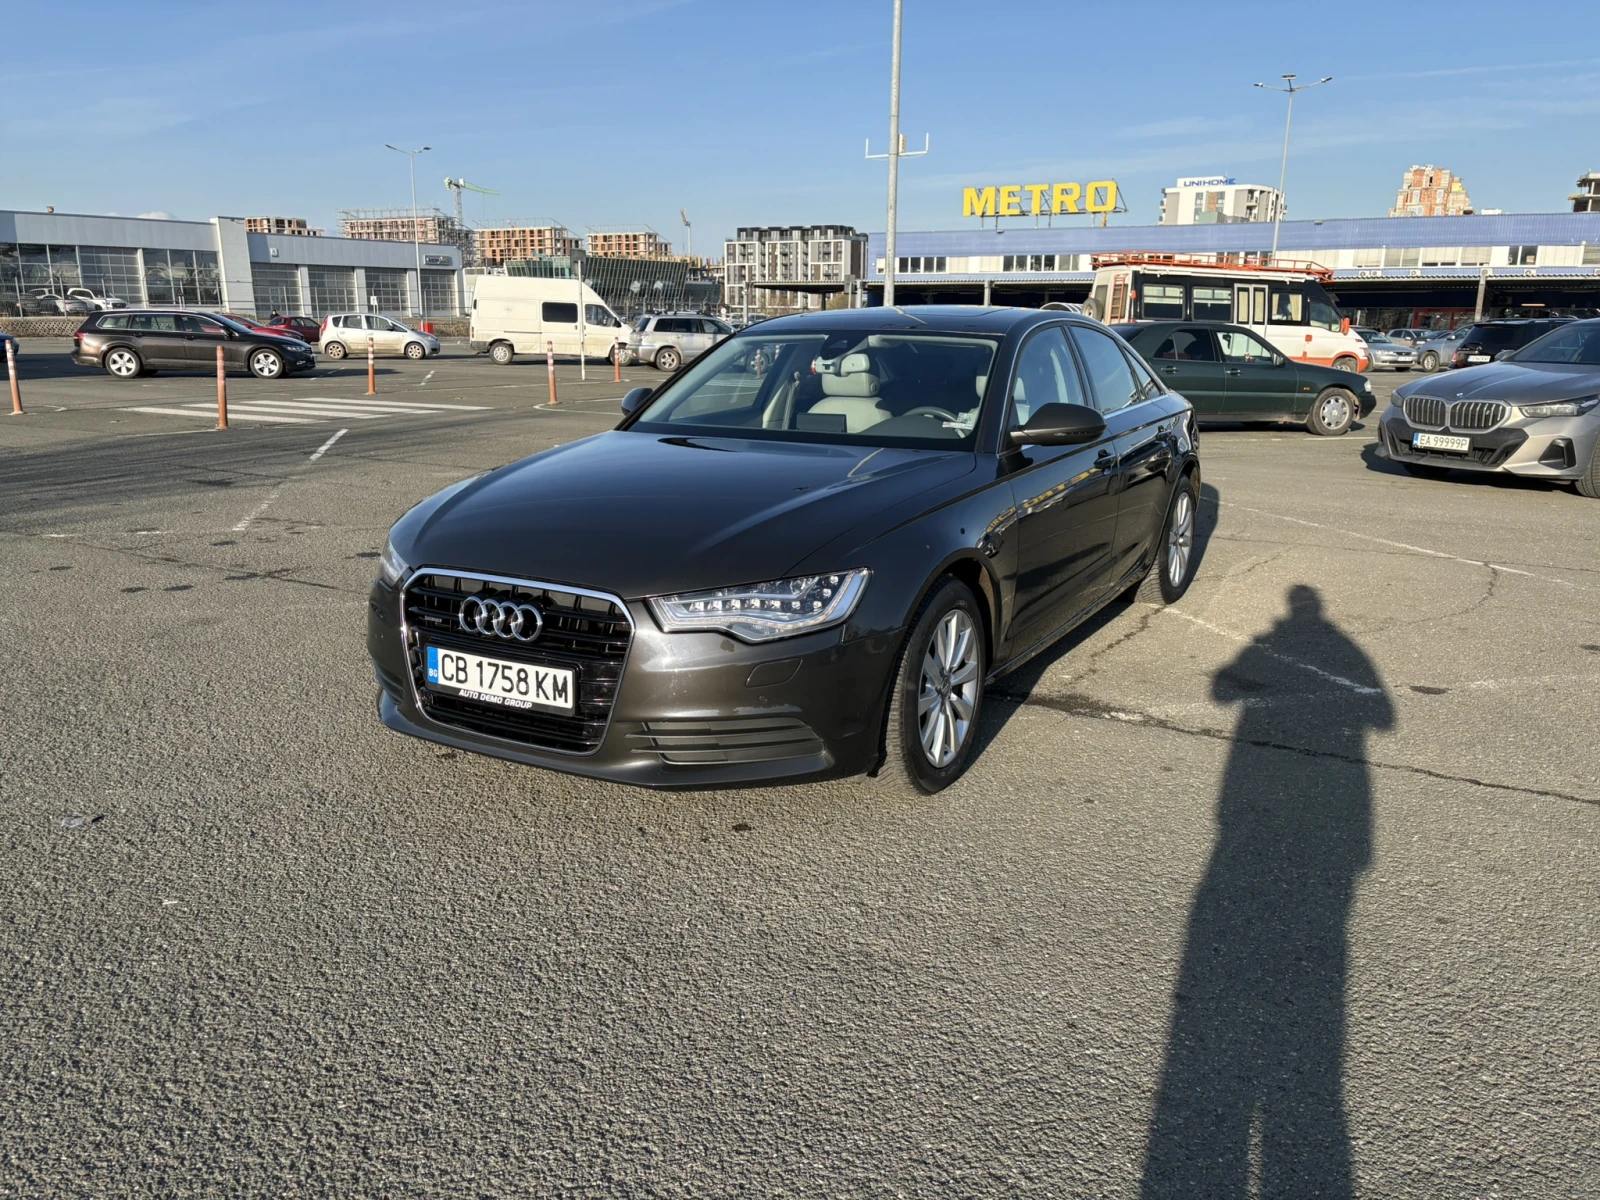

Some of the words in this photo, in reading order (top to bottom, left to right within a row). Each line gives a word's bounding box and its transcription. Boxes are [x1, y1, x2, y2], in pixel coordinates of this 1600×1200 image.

[1183, 178, 1236, 187] UNIHOME
[963, 180, 1117, 217] METRO
[1419, 435, 1431, 446] EA
[1433, 436, 1468, 449] 99999P
[428, 669, 438, 678] BG
[441, 654, 468, 684] CB
[476, 660, 530, 696] 1758
[535, 670, 568, 703] KM
[459, 689, 479, 699] AUTO
[480, 694, 503, 704] DEMO
[504, 698, 533, 709] GROUP
